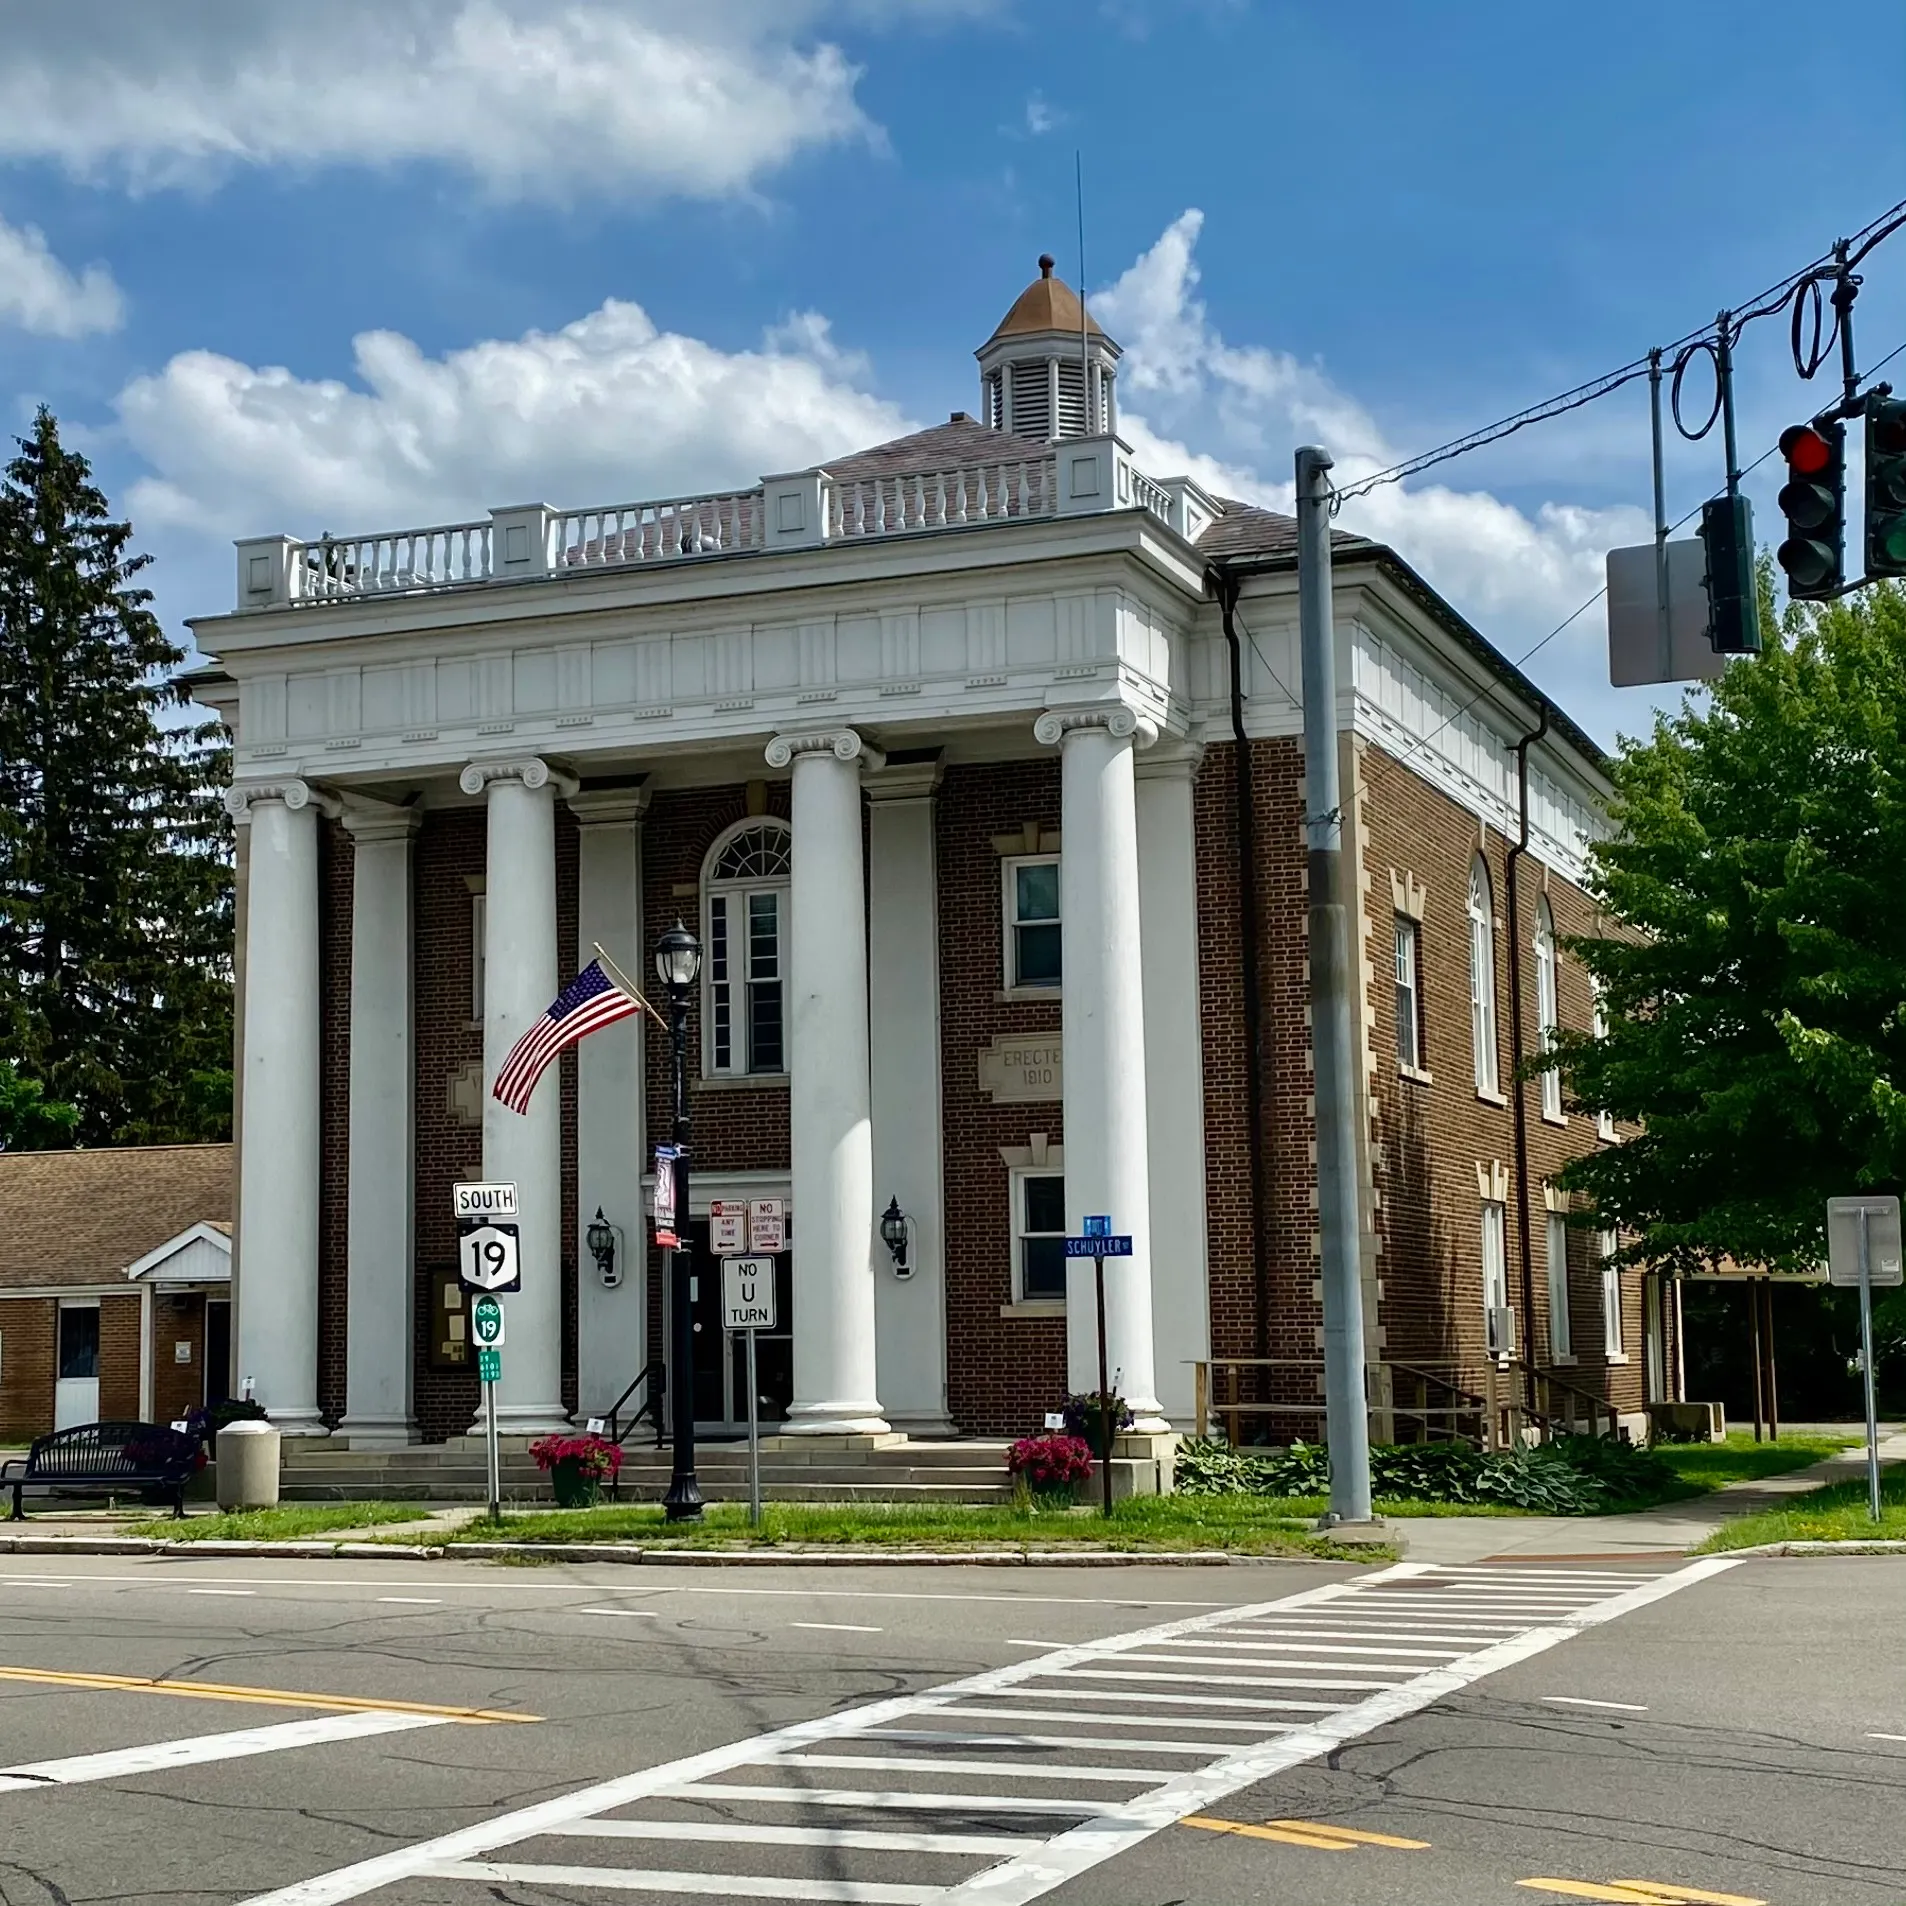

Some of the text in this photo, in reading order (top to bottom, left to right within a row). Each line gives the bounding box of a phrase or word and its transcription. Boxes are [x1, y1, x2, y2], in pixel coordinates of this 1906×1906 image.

[1004, 1048, 1061, 1066] ERECTE
[460, 1190, 513, 1209] SOUTH
[760, 1203, 773, 1213] NO
[773, 1224, 781, 1232] TO
[1067, 1240, 1121, 1254] SCHUYLER
[471, 1241, 506, 1276] 19
[738, 1263, 758, 1276] NO
[742, 1283, 755, 1302] U
[731, 1308, 768, 1322] TURN
[481, 1321, 496, 1337] 19
